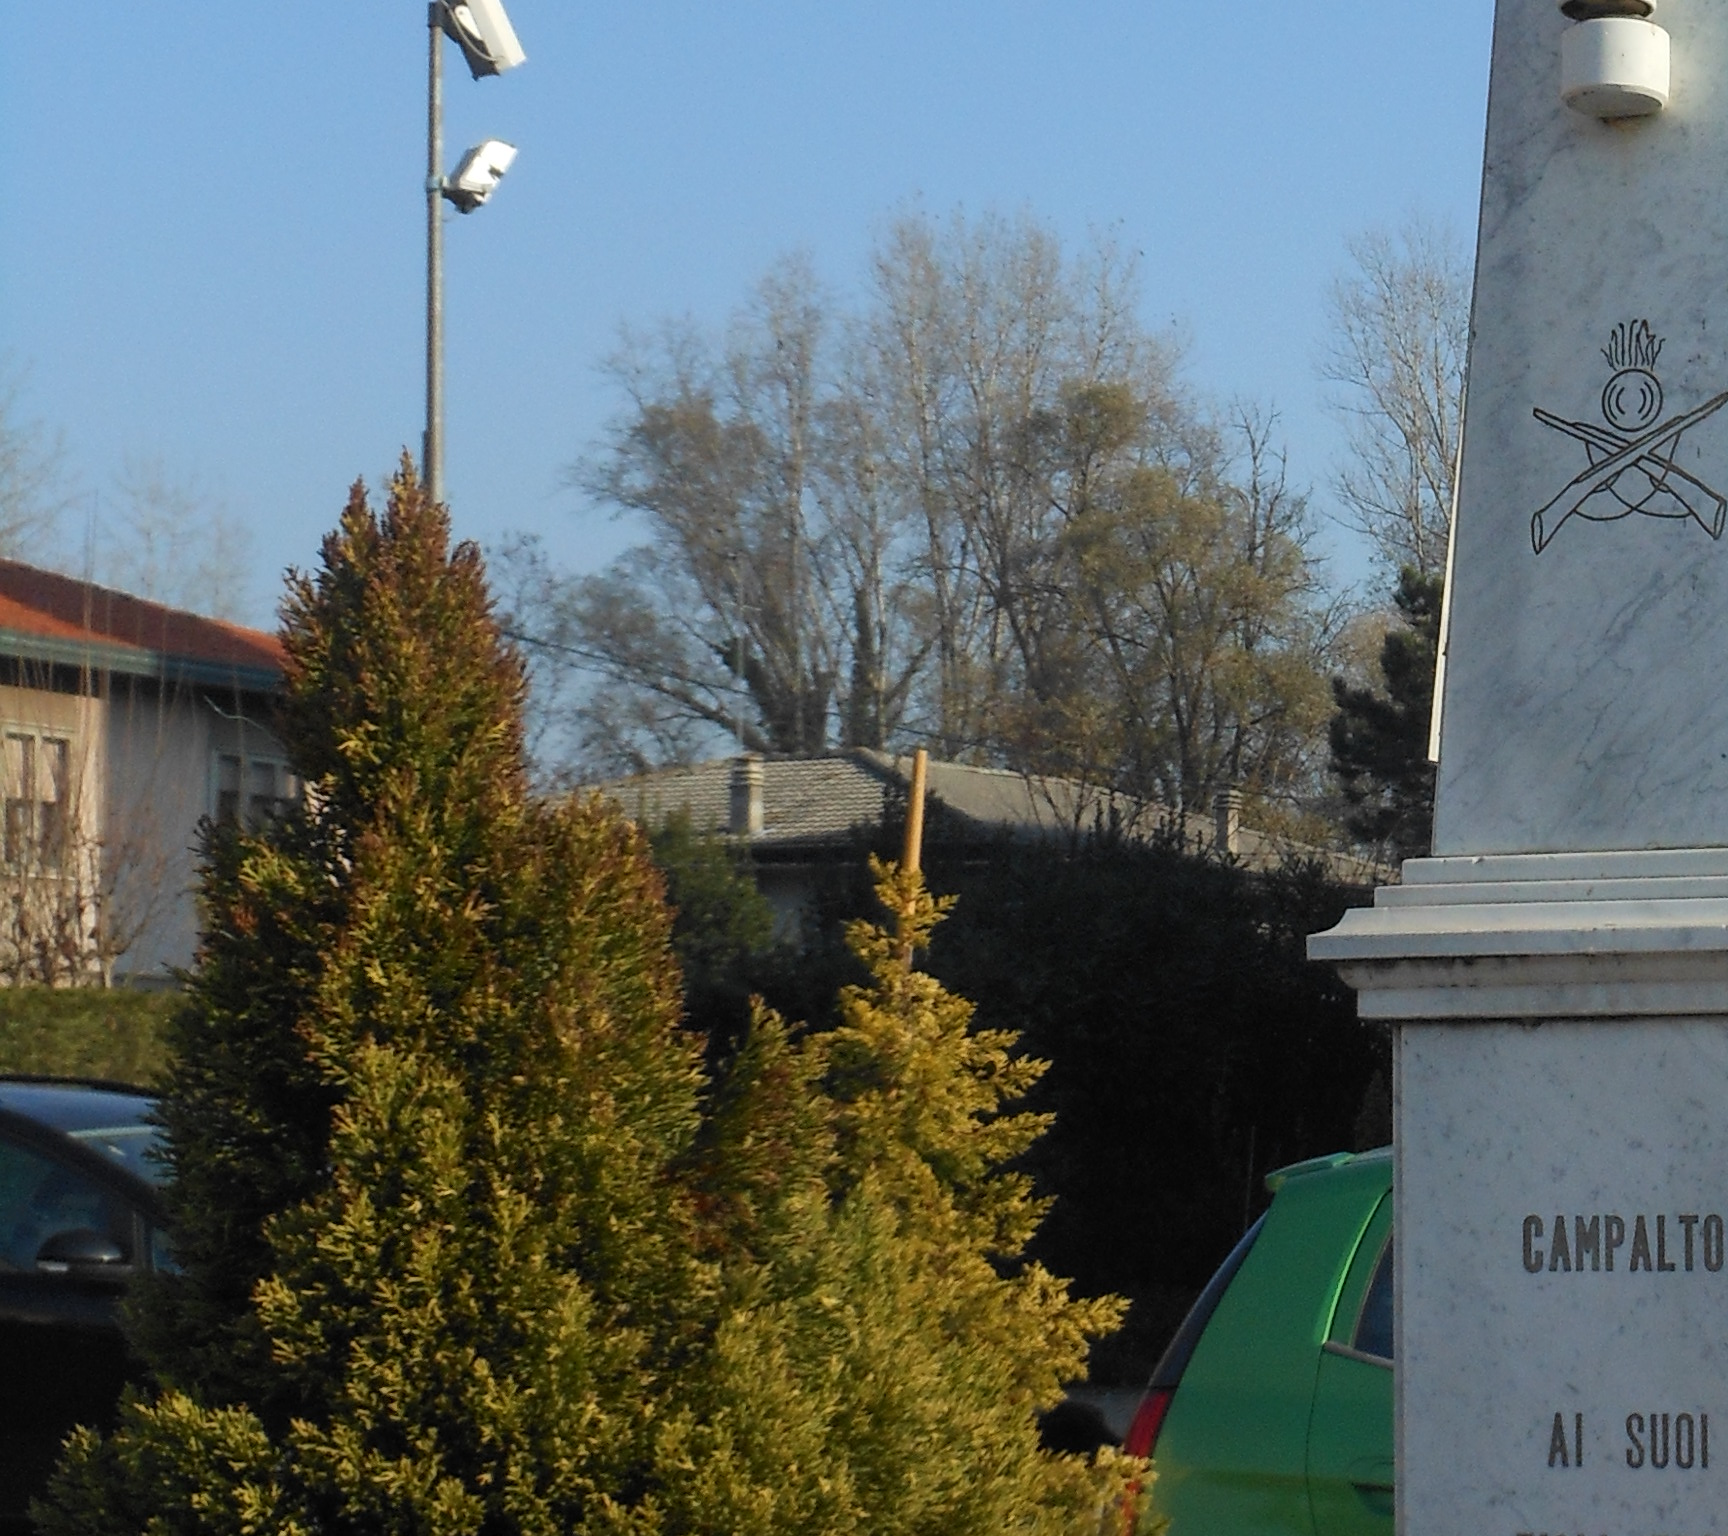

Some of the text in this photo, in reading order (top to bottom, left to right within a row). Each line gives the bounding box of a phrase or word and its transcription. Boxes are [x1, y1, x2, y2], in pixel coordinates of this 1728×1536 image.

[1522, 1214, 1725, 1273] CAMPALTO
[1548, 1411, 1709, 1469] AI SUOI
